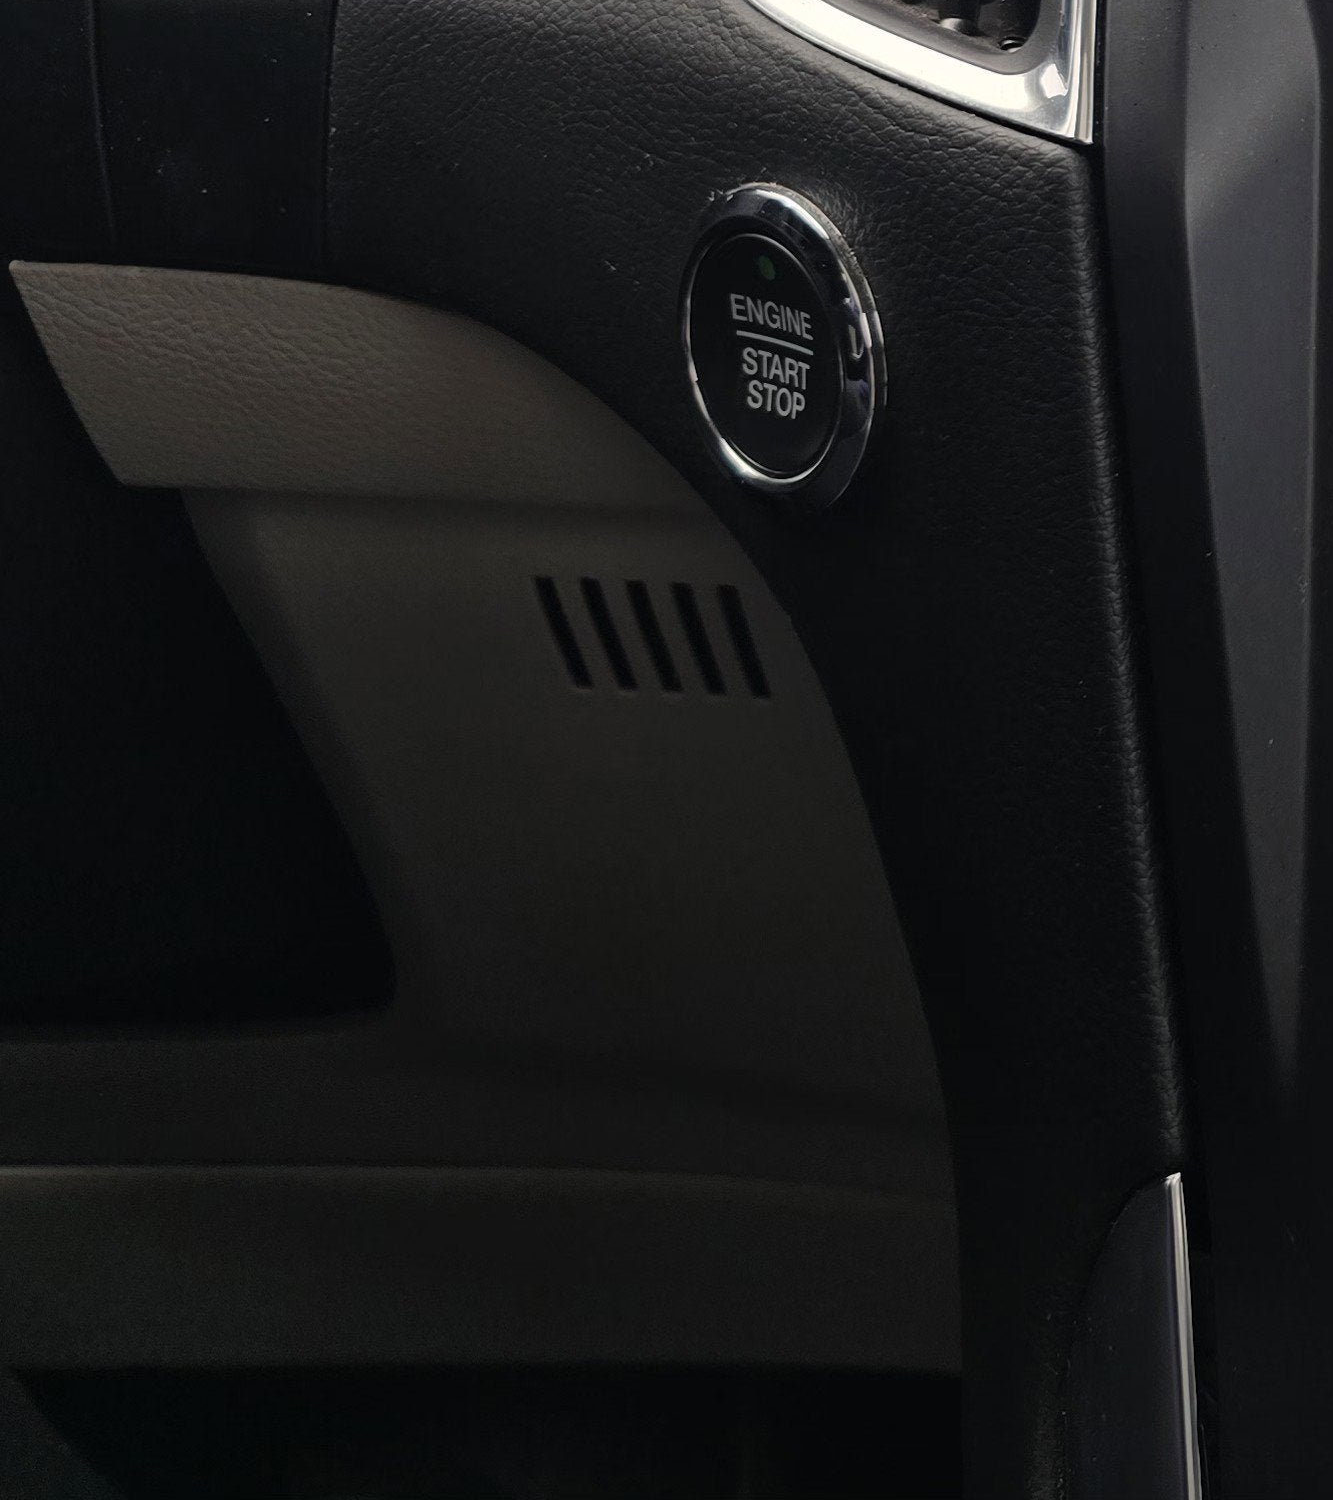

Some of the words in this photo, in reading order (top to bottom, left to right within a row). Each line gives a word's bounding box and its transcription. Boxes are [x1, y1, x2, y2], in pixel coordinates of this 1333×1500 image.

[729, 293, 814, 341] ENGINE
[742, 347, 811, 390] START
[747, 379, 806, 420] STOP
